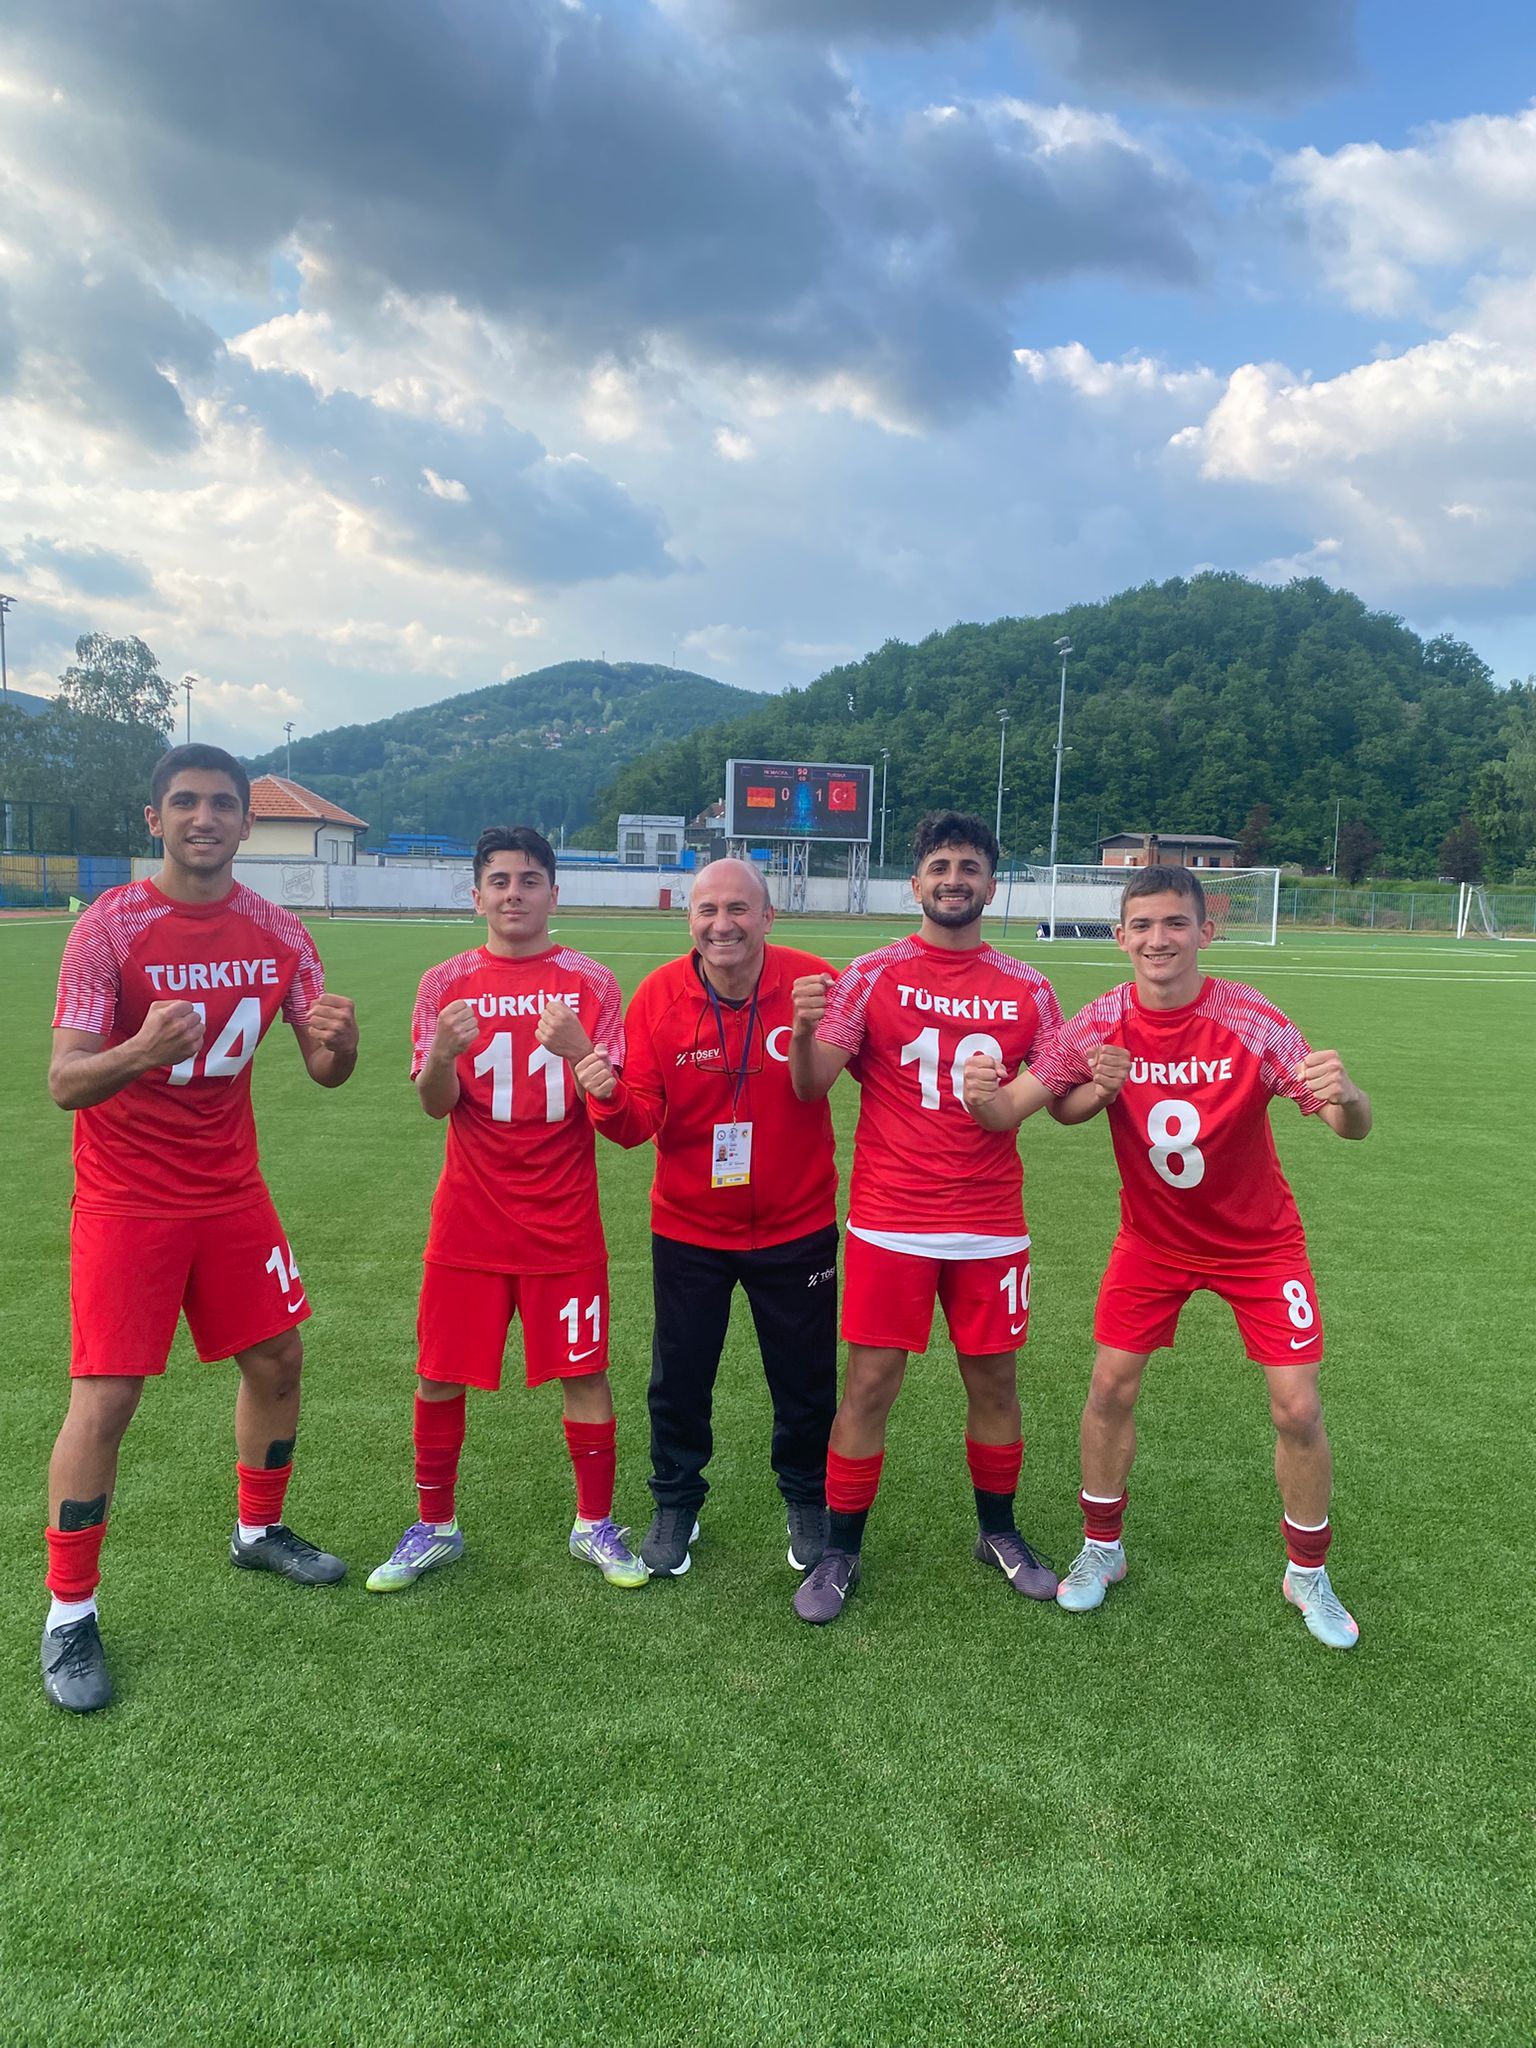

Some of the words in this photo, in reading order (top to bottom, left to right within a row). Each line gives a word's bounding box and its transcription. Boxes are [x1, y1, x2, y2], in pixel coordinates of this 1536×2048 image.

[781, 787, 790, 801] 0
[816, 789, 822, 802] 1
[145, 958, 279, 991] TÜRKİYE
[897, 984, 1019, 1021] TÜRKİYE
[473, 1031, 566, 1123] 11
[900, 1026, 1004, 1114] 10
[1129, 1056, 1233, 1085] ÜRKİYE
[1147, 1099, 1205, 1189] 8
[1000, 1262, 1032, 1315] 10
[1282, 1279, 1314, 1329] 8
[559, 1294, 600, 1344] 11
